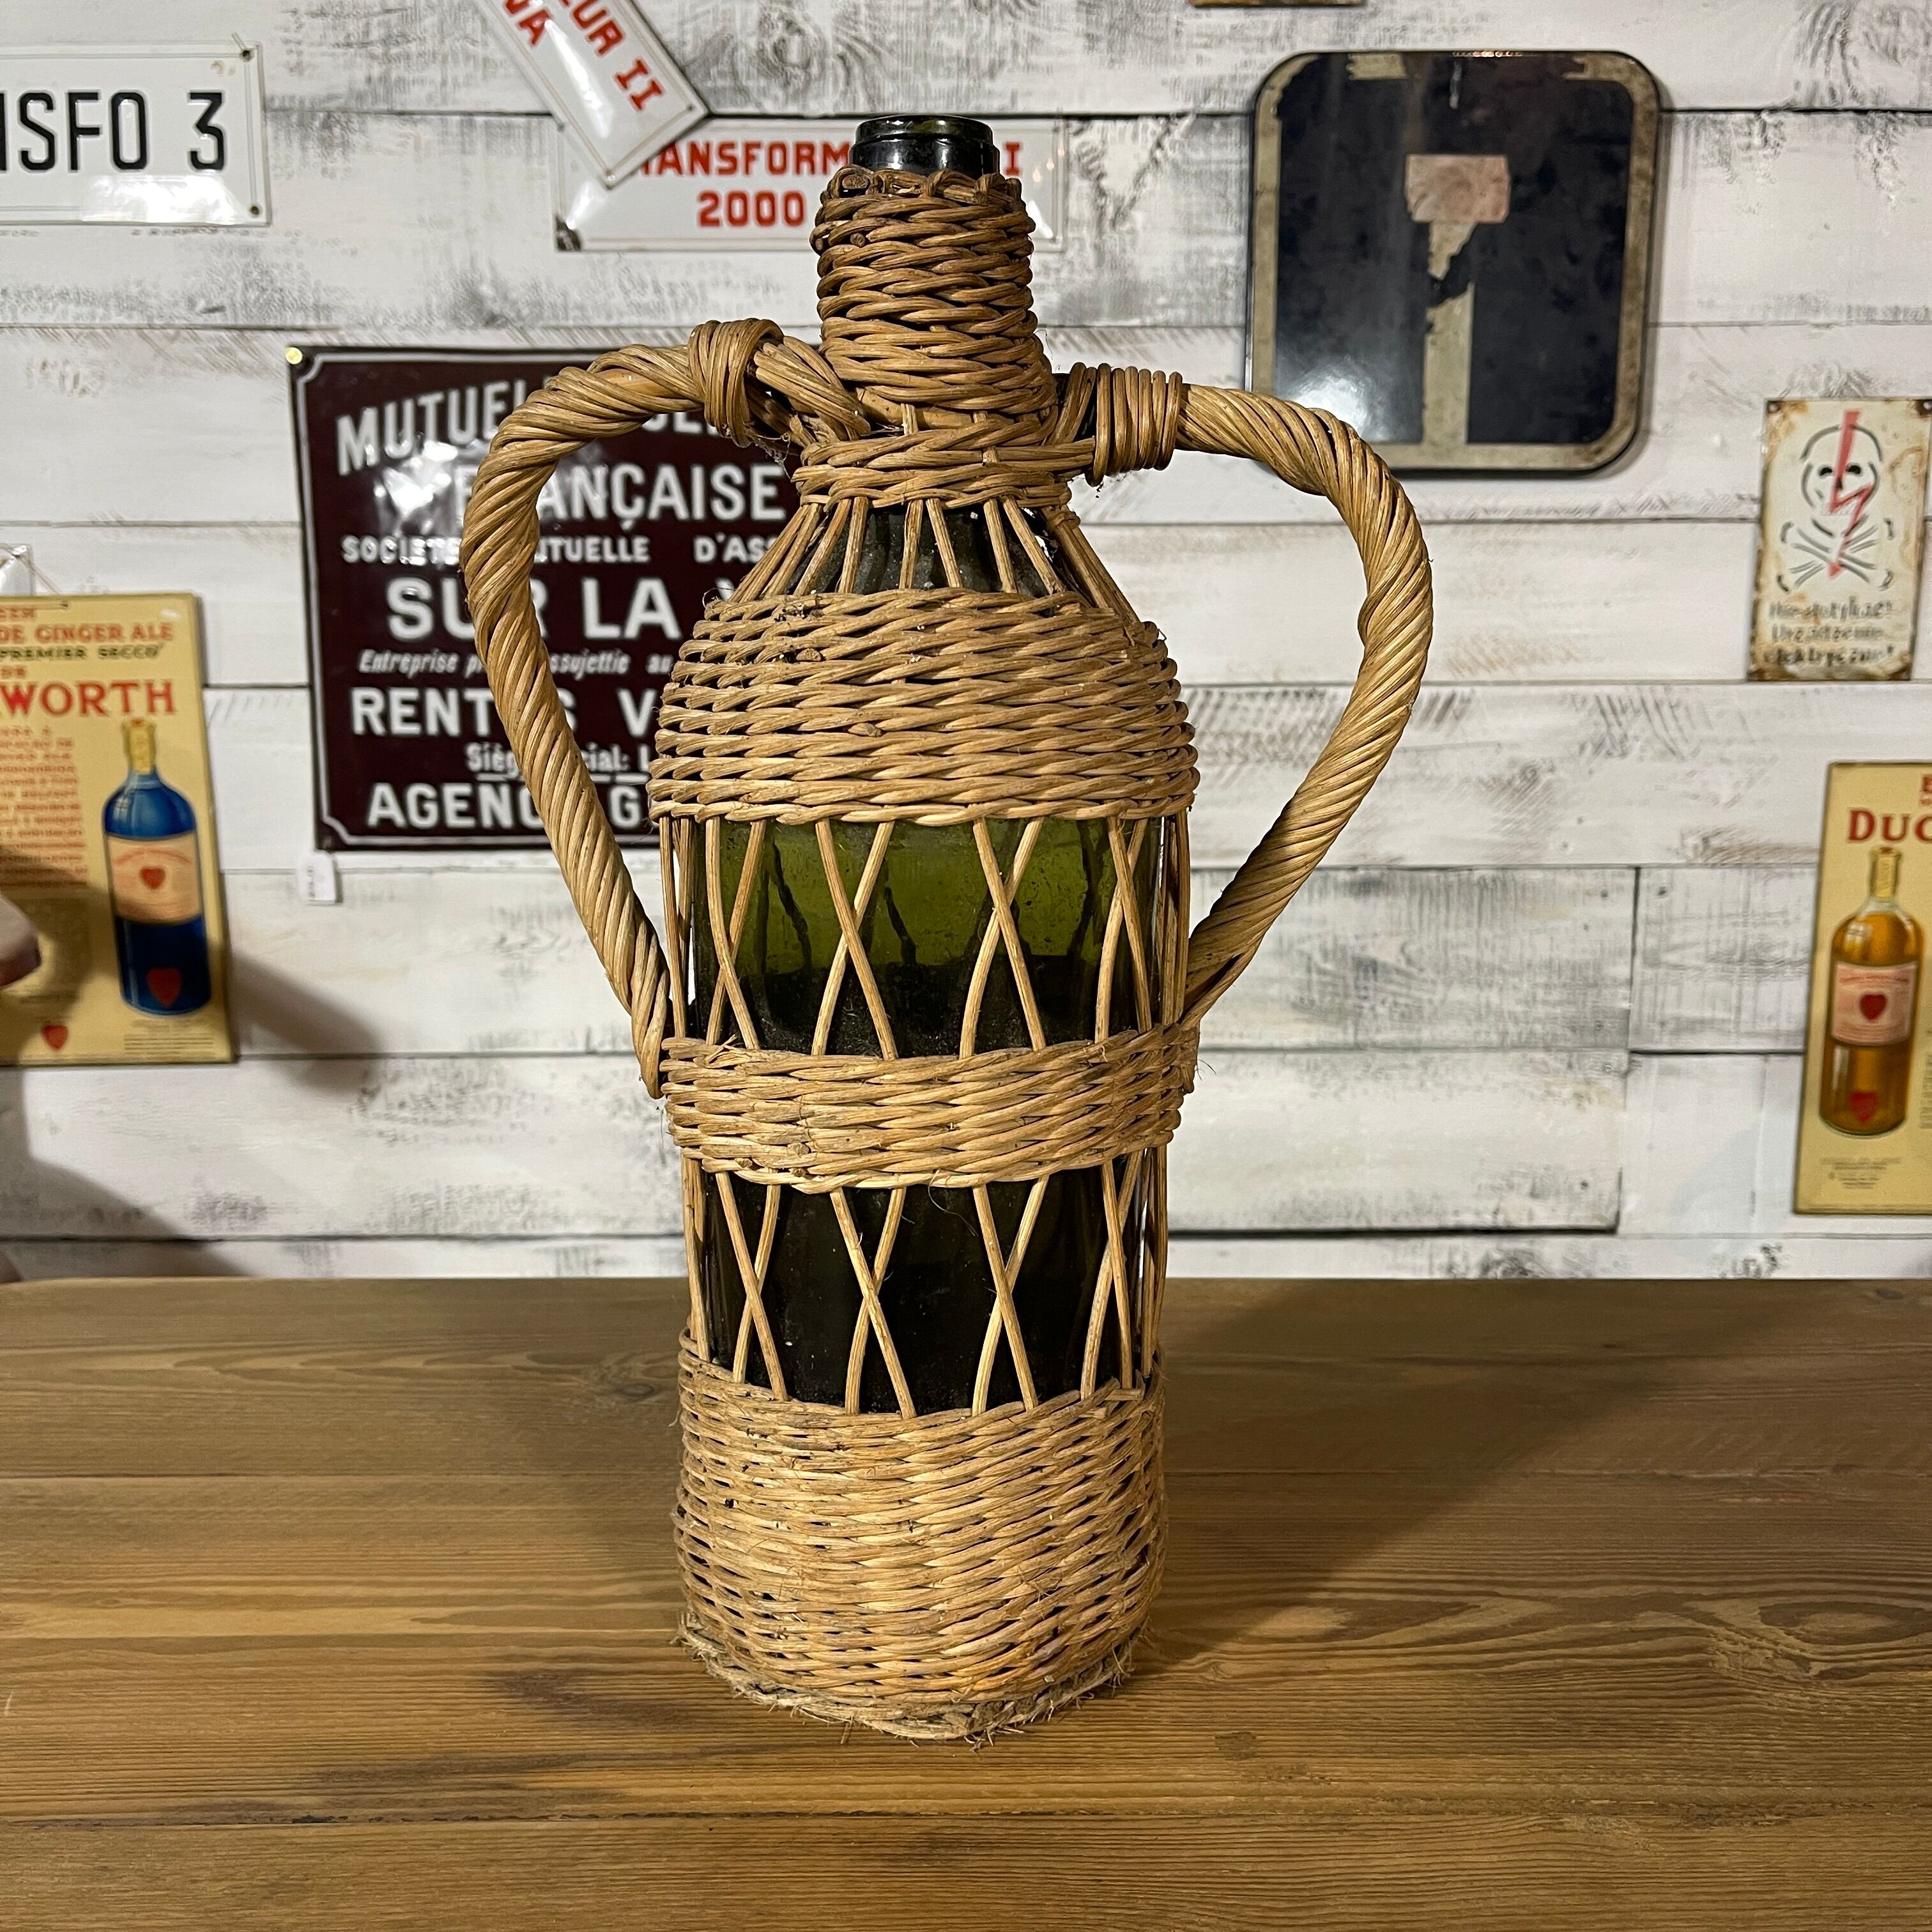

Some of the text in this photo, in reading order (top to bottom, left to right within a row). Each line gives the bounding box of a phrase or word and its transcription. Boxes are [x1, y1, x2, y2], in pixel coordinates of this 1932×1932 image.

[560, 0, 624, 55] UR
[0, 91, 225, 171] SFO 3
[640, 140, 852, 176] ANSFORM
[698, 190, 806, 227] 2000
[450, 462, 786, 531] FANÇAISE
[534, 535, 650, 562] UTUELLE
[580, 577, 682, 640] LA
[34, 624, 124, 643] GINGER
[131, 621, 174, 641] ALE
[359, 648, 459, 678] Entreprise
[549, 648, 631, 681] ssujettie
[367, 783, 542, 829] AGENC
